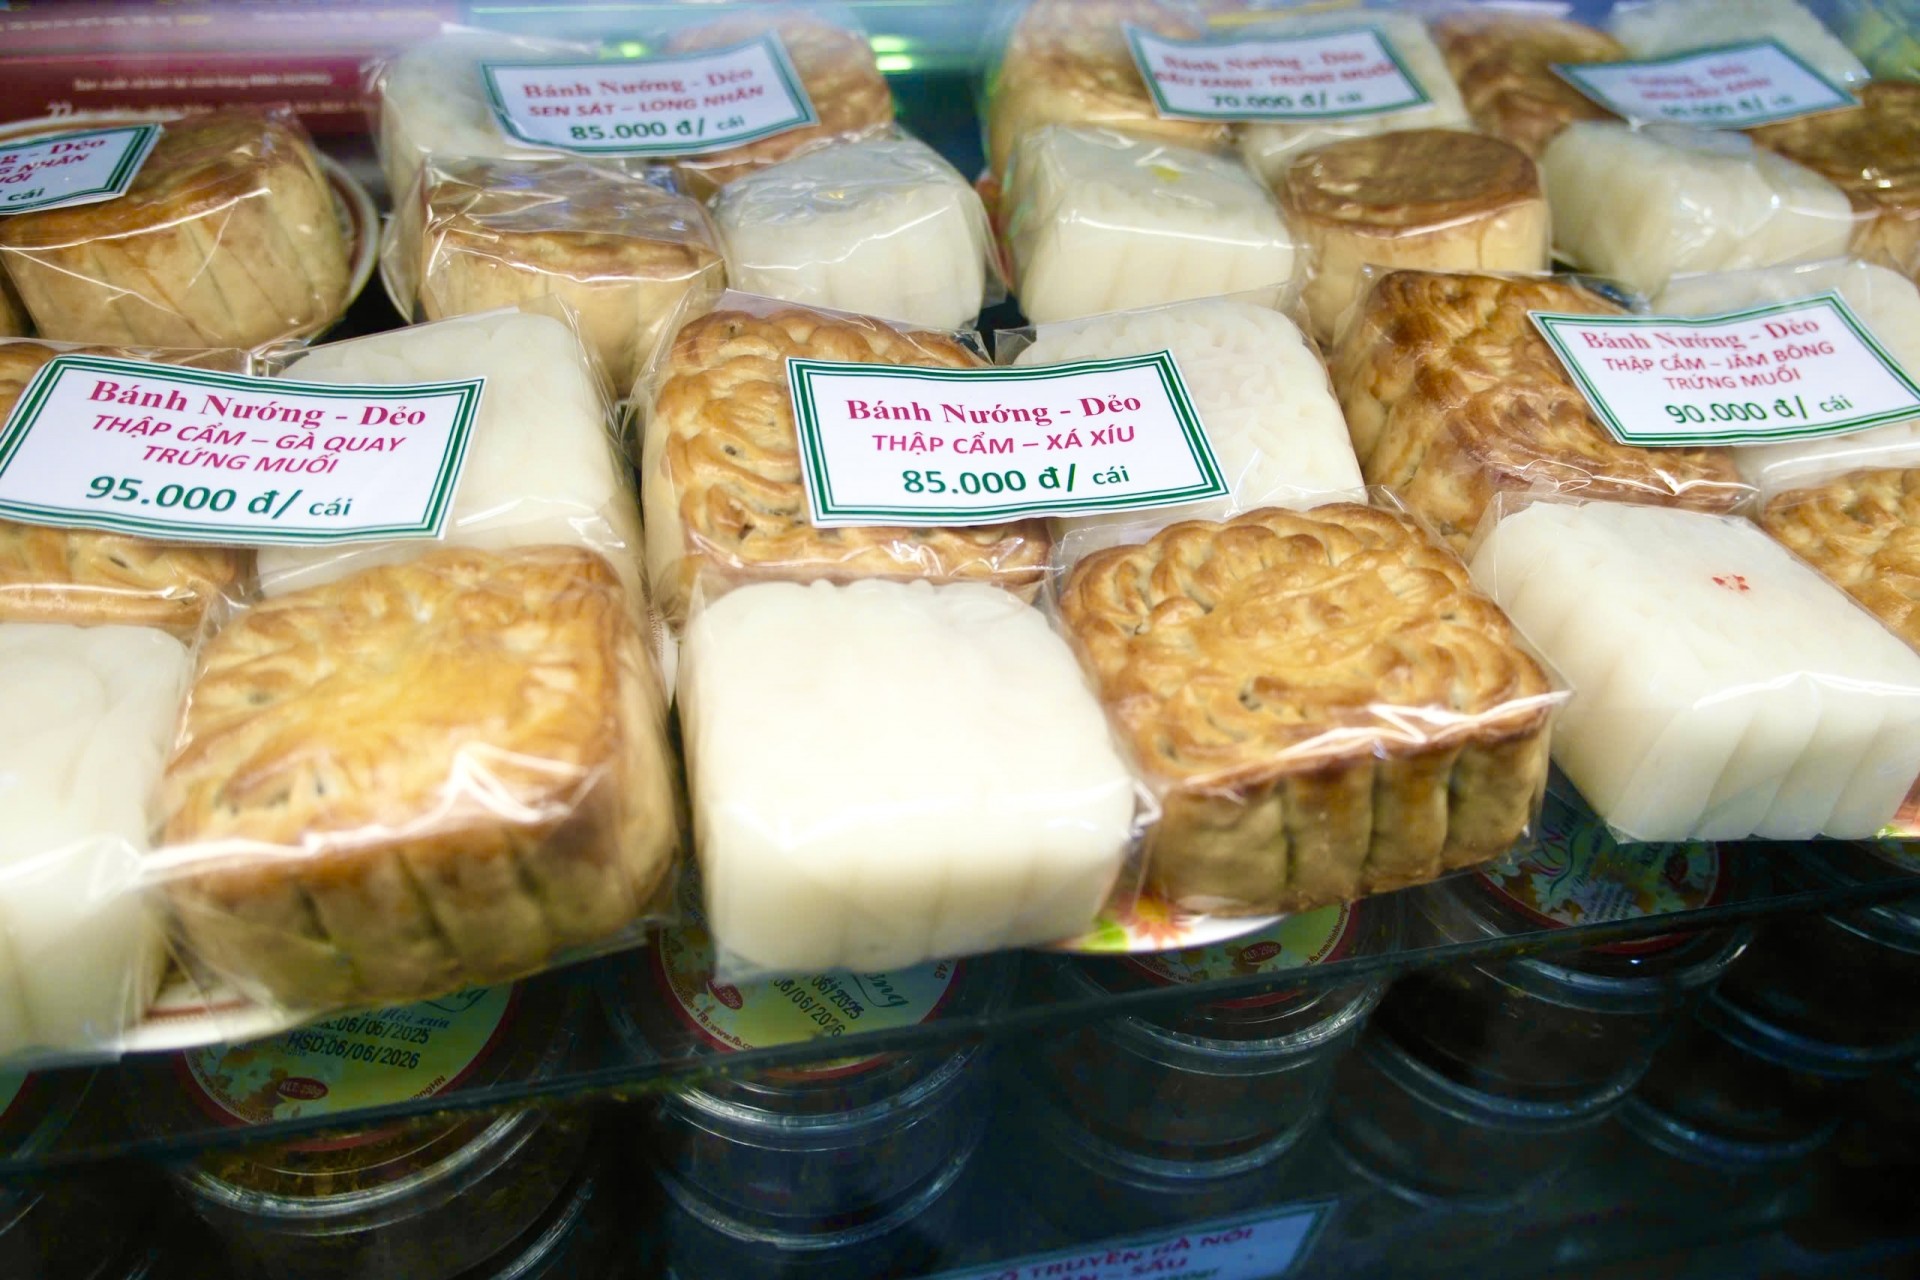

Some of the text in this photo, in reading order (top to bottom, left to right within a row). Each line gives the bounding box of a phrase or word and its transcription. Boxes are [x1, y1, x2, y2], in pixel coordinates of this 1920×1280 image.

[523, 82, 592, 98] Bánh
[597, 79, 686, 95] Nướng
[528, 105, 570, 117] SEN
[577, 102, 615, 117] SÁT
[640, 98, 698, 113] LONG
[570, 121, 667, 141] 85.000
[1579, 330, 1653, 350] Bánh
[1653, 331, 1748, 350] Nướng
[1763, 318, 1821, 340] Dẻo
[1602, 355, 1655, 375] THẬP
[1659, 352, 1707, 371] CẨM
[1773, 341, 1836, 363] BÔNG
[1662, 364, 1802, 391] TRỨNG MUỐI
[86, 380, 189, 412] Bánh
[197, 394, 326, 430] Nướng
[358, 404, 427, 427] Dẻo
[846, 398, 932, 423] Bánh
[939, 398, 1053, 427] Nướng
[1076, 393, 1142, 419] Dẻo
[1664, 401, 1768, 425] 90.000
[1818, 393, 1855, 414] cái
[92, 414, 173, 439] THẬP
[176, 421, 248, 447] CẨM
[275, 431, 316, 451] GÀ
[322, 435, 408, 454] QUAY
[871, 431, 945, 456] THẬP
[952, 430, 1016, 455] CẨM
[1046, 428, 1083, 452] XÁ
[1089, 424, 1137, 447] XÍU
[142, 445, 340, 475] TRỨNG MUỐI
[85, 475, 238, 513] 95.000
[307, 497, 354, 517] cái
[901, 468, 1028, 496] 85.000
[1091, 465, 1131, 486] cái
[286, 1030, 421, 1070] HSD:06/06/2026
